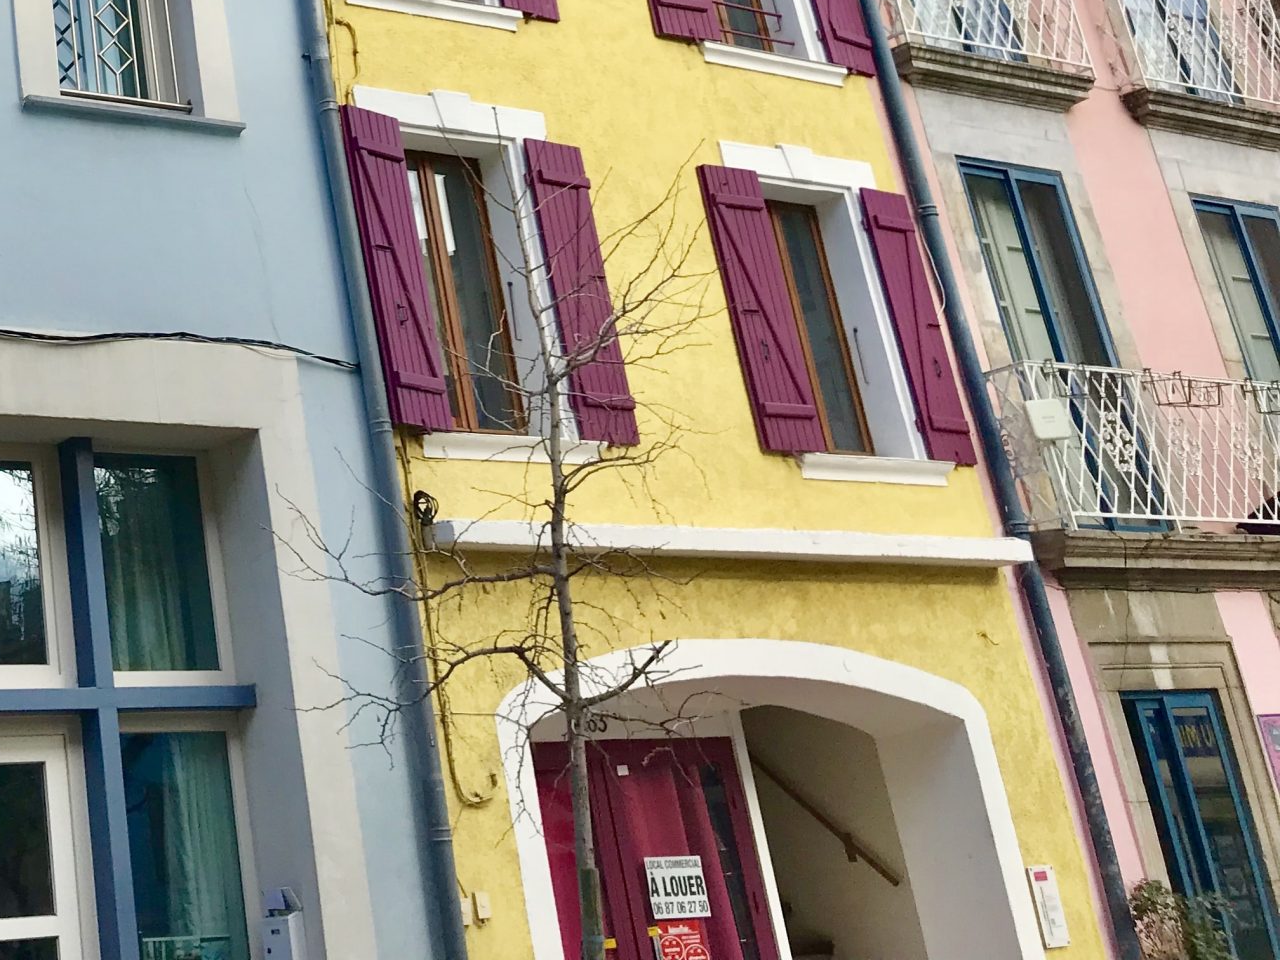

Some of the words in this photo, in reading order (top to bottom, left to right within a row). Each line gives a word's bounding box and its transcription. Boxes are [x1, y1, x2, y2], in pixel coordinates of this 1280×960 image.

[646, 860, 664, 870] LOCAL
[665, 858, 701, 869] COMMERCIAL
[650, 871, 661, 897] À
[662, 875, 705, 897] LOUER
[653, 902, 664, 915] 06
[665, 901, 674, 915] 87
[687, 900, 697, 913] 27
[698, 900, 708, 913] 50
